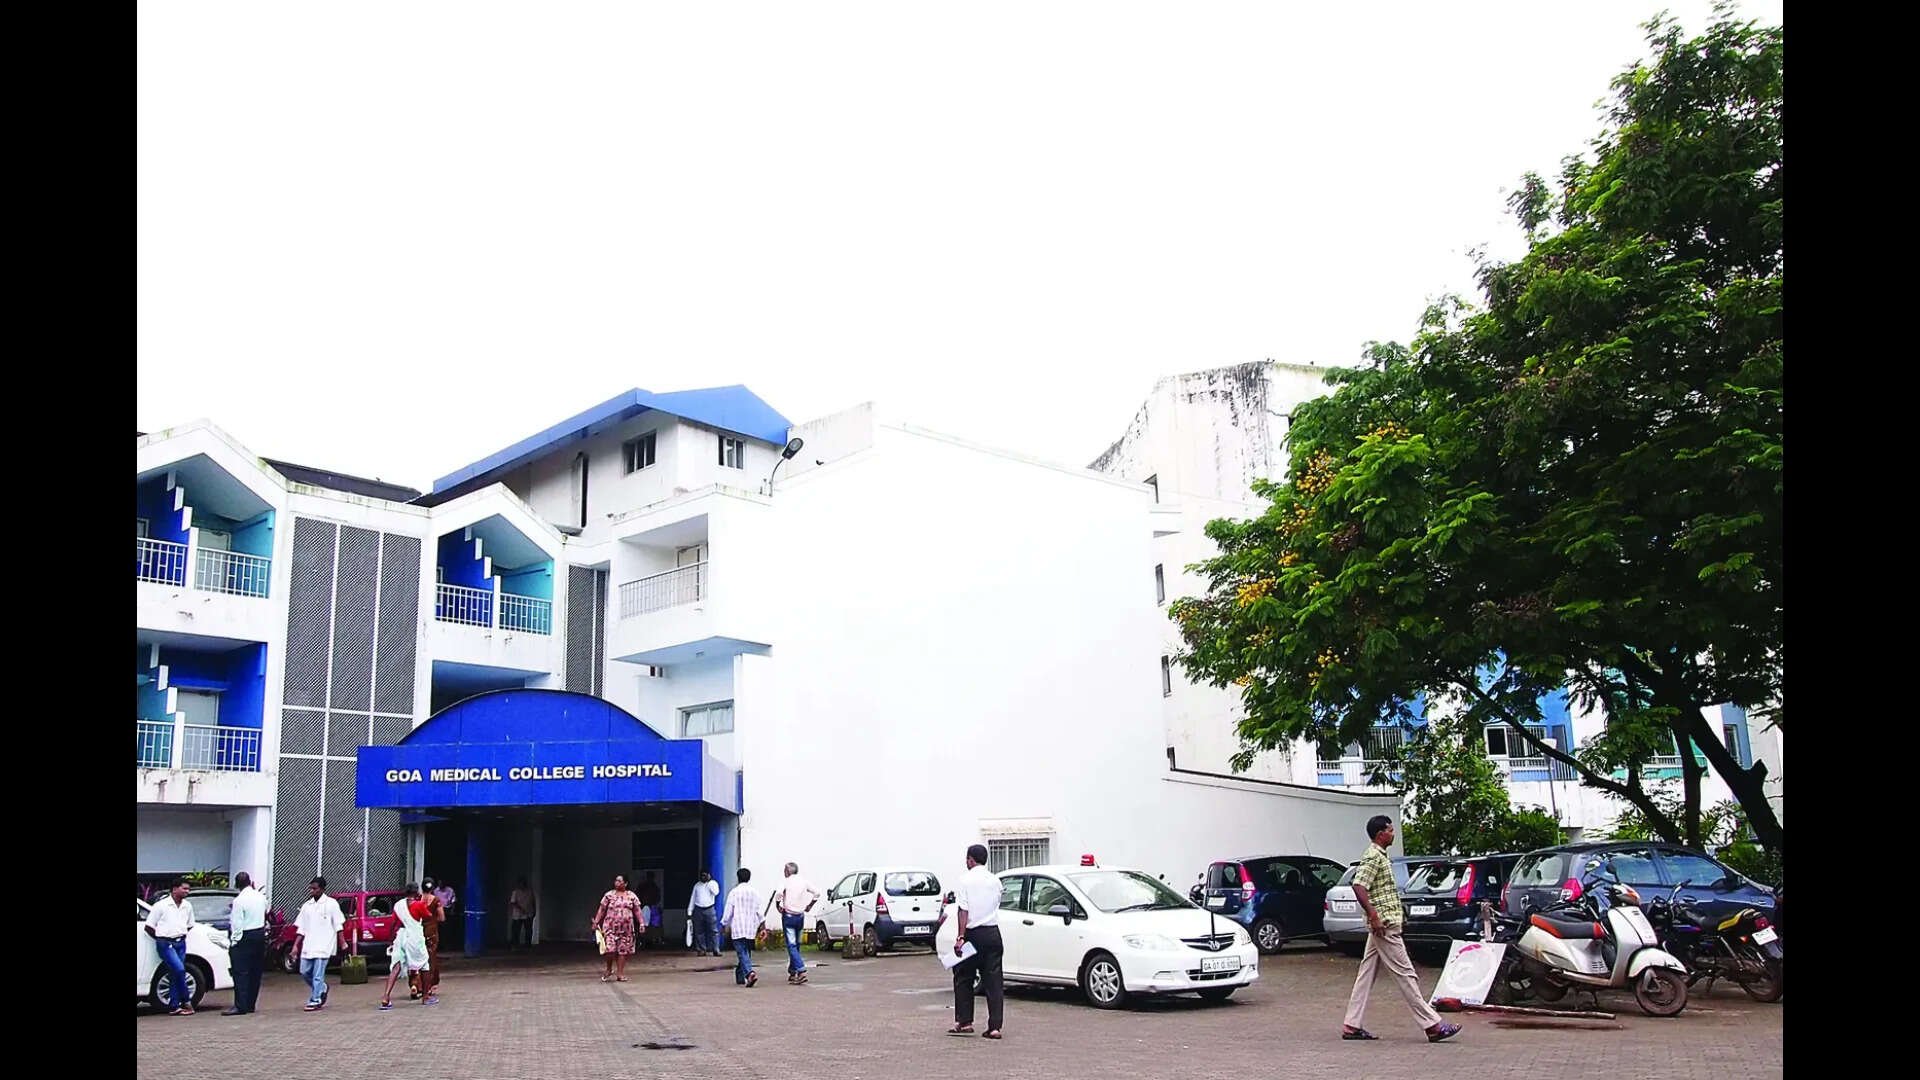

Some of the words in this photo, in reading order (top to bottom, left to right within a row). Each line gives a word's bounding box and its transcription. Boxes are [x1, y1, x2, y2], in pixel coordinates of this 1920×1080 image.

[386, 770, 422, 783] GOA
[431, 768, 501, 781] MEDICAL
[509, 766, 584, 780] COLLEGE
[593, 764, 673, 778] HOSPITAL
[1203, 962, 1212, 971] GA
